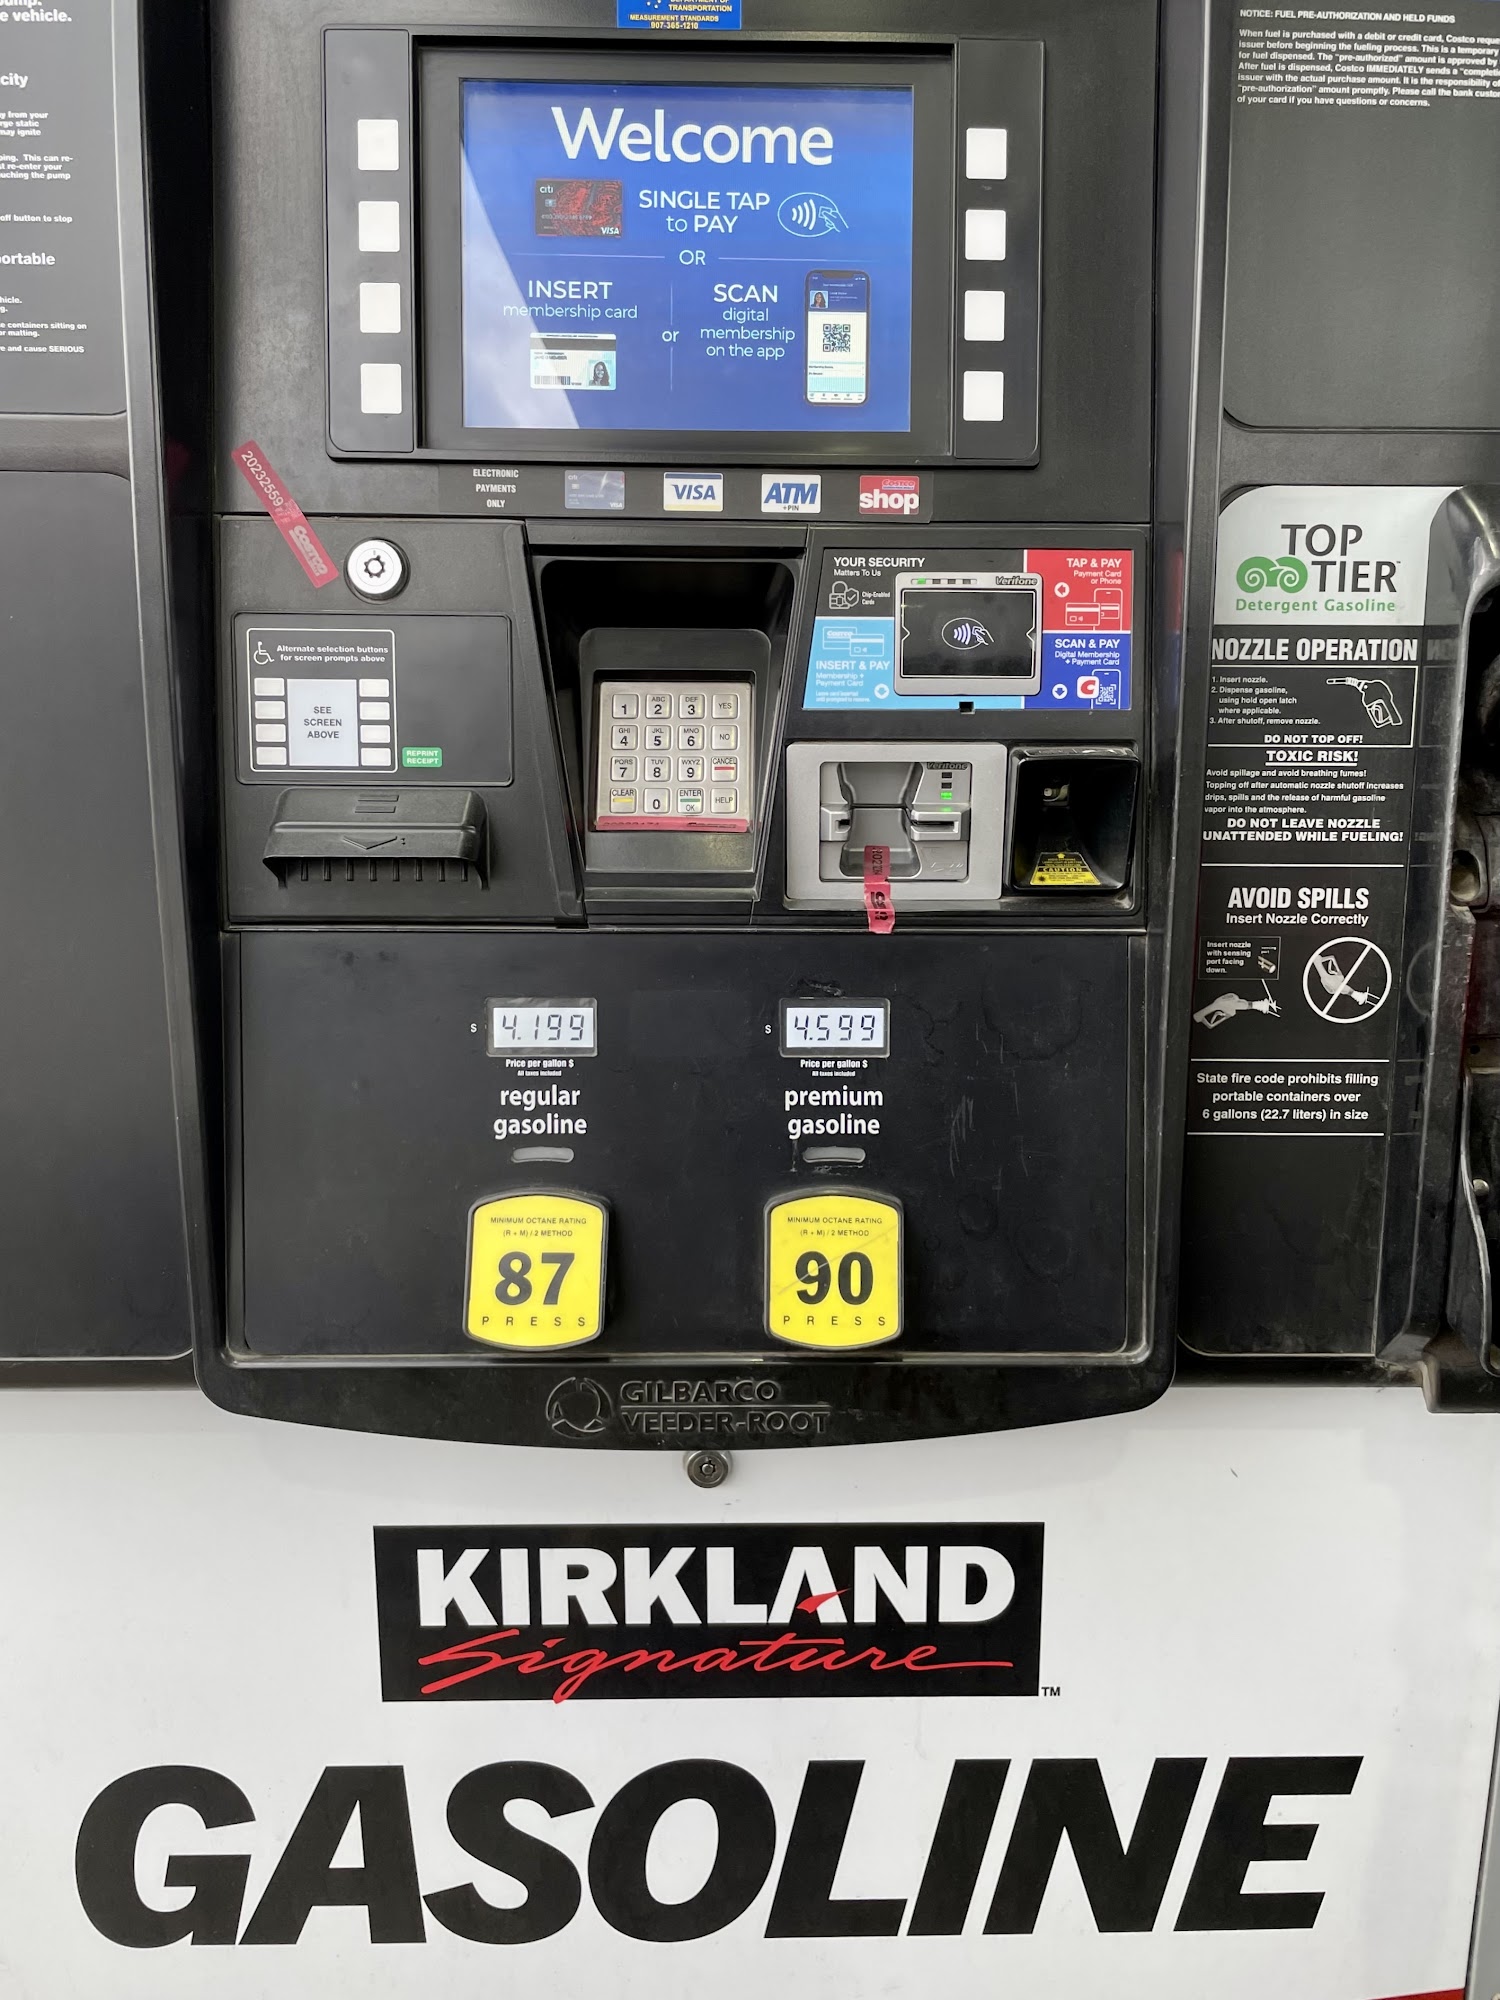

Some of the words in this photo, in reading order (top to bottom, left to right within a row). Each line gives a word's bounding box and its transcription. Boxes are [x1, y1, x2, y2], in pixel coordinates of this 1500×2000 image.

[12, 8, 72, 22] vehicle.
[1274, 10, 1296, 18] FUEL
[1297, 10, 1382, 20] PRE-AUTHORIZATION
[1382, 12, 1401, 21] AND
[1402, 13, 1425, 22] HELD
[1426, 14, 1455, 23] FUNDS
[551, 106, 833, 165] Welcome
[639, 189, 720, 209] SINGLE
[726, 192, 770, 210] TAP
[53, 214, 72, 223] stop
[666, 215, 687, 232] to
[694, 214, 738, 232] PAY
[679, 249, 705, 265] OR
[528, 280, 612, 299] INSERT
[713, 283, 777, 302] SCAN
[502, 301, 600, 321] membership
[604, 305, 637, 318] card
[722, 307, 768, 323] digital
[7, 322, 48, 330] containers
[50, 322, 75, 330] sitting
[662, 330, 679, 342] or
[700, 326, 795, 344] membership
[706, 346, 724, 356] on
[728, 343, 753, 356] the
[756, 347, 784, 360] app
[242, 451, 284, 506] 20232559
[472, 468, 518, 477] ELECTRONIC
[475, 484, 516, 492] PAYMENTS
[672, 484, 715, 500] VISA
[764, 483, 818, 504] ATM
[486, 499, 505, 507] ONLY
[860, 489, 919, 514] shop
[1281, 524, 1363, 556] TOP
[833, 556, 865, 566] YOUR
[868, 557, 925, 567] SECURITY
[1066, 558, 1087, 567] TAP
[1090, 558, 1098, 567] &
[1100, 558, 1122, 567] PAY
[995, 576, 1037, 585] Verifone
[1311, 560, 1398, 592] TIER
[1235, 598, 1317, 613] Detergent
[1324, 598, 1395, 611] Gasoline
[276, 644, 314, 654] Alternate
[1054, 638, 1085, 648] SCAN
[1088, 638, 1096, 648] &
[1099, 638, 1120, 648] PAY
[1212, 638, 1289, 660] NOZZLE
[1296, 638, 1417, 661] OPERATION
[816, 660, 856, 670] INSERT
[858, 660, 866, 670] &
[869, 660, 890, 670] PAY
[622, 704, 627, 714] 1
[654, 705, 662, 714] 2
[688, 705, 695, 715] 3
[307, 730, 339, 738] ABOVE
[620, 736, 628, 746] 4
[654, 736, 661, 746] 5
[687, 736, 695, 746] 6
[1264, 734, 1280, 743] DO
[1284, 734, 1308, 743] NOT
[1311, 734, 1334, 743] TOP
[1337, 734, 1362, 743] OFF!
[1266, 750, 1313, 761] TOXIC
[1317, 750, 1358, 761] RISK!
[620, 768, 627, 777] 7
[654, 767, 661, 777] 8
[687, 768, 694, 778] 9
[653, 799, 660, 809] 0
[1227, 818, 1246, 828] DO
[1250, 818, 1278, 828] NOT
[1281, 818, 1323, 828] LEAVE
[1327, 818, 1380, 828] NOZZLE
[1203, 831, 1292, 841] UNATTENDED
[1295, 831, 1338, 841] WHILE
[1341, 831, 1403, 841] FUELING!
[1227, 887, 1291, 908] AVOID
[1297, 887, 1369, 909] SPILLS
[1226, 912, 1262, 923] Insert
[1265, 913, 1307, 923] Nozzle
[1311, 913, 1368, 926] Correctly
[502, 1014, 584, 1040] 4.199
[794, 1014, 875, 1040] 4.599
[1197, 1073, 1228, 1083] State
[1231, 1072, 1251, 1083] fire
[1254, 1073, 1284, 1083] code
[1287, 1073, 1342, 1086] prohibits
[1344, 1073, 1378, 1086] filling
[500, 1084, 580, 1113] regular
[784, 1084, 882, 1113] premium
[1212, 1090, 1263, 1103] portable
[1266, 1090, 1330, 1101] containers
[1333, 1093, 1361, 1101] over
[1202, 1108, 1209, 1118] 6
[1213, 1108, 1257, 1121] gallons
[1260, 1108, 1289, 1121] (22.7
[1292, 1108, 1326, 1122] liters)
[1329, 1108, 1340, 1119] in
[1344, 1108, 1368, 1119] size
[493, 1112, 586, 1139] gasoline
[788, 1112, 879, 1139] gasoline
[494, 1251, 574, 1305] 87
[795, 1251, 873, 1304] 90
[482, 1316, 585, 1326] PRESS
[783, 1315, 885, 1326] PRESS
[620, 1380, 780, 1402] GILBARCO
[622, 1411, 830, 1434] VEEDER-ROOT
[418, 1546, 1016, 1627] KIRKLAND
[418, 1629, 1013, 1703] Signature
[75, 1755, 1364, 1948] GASOLINE
